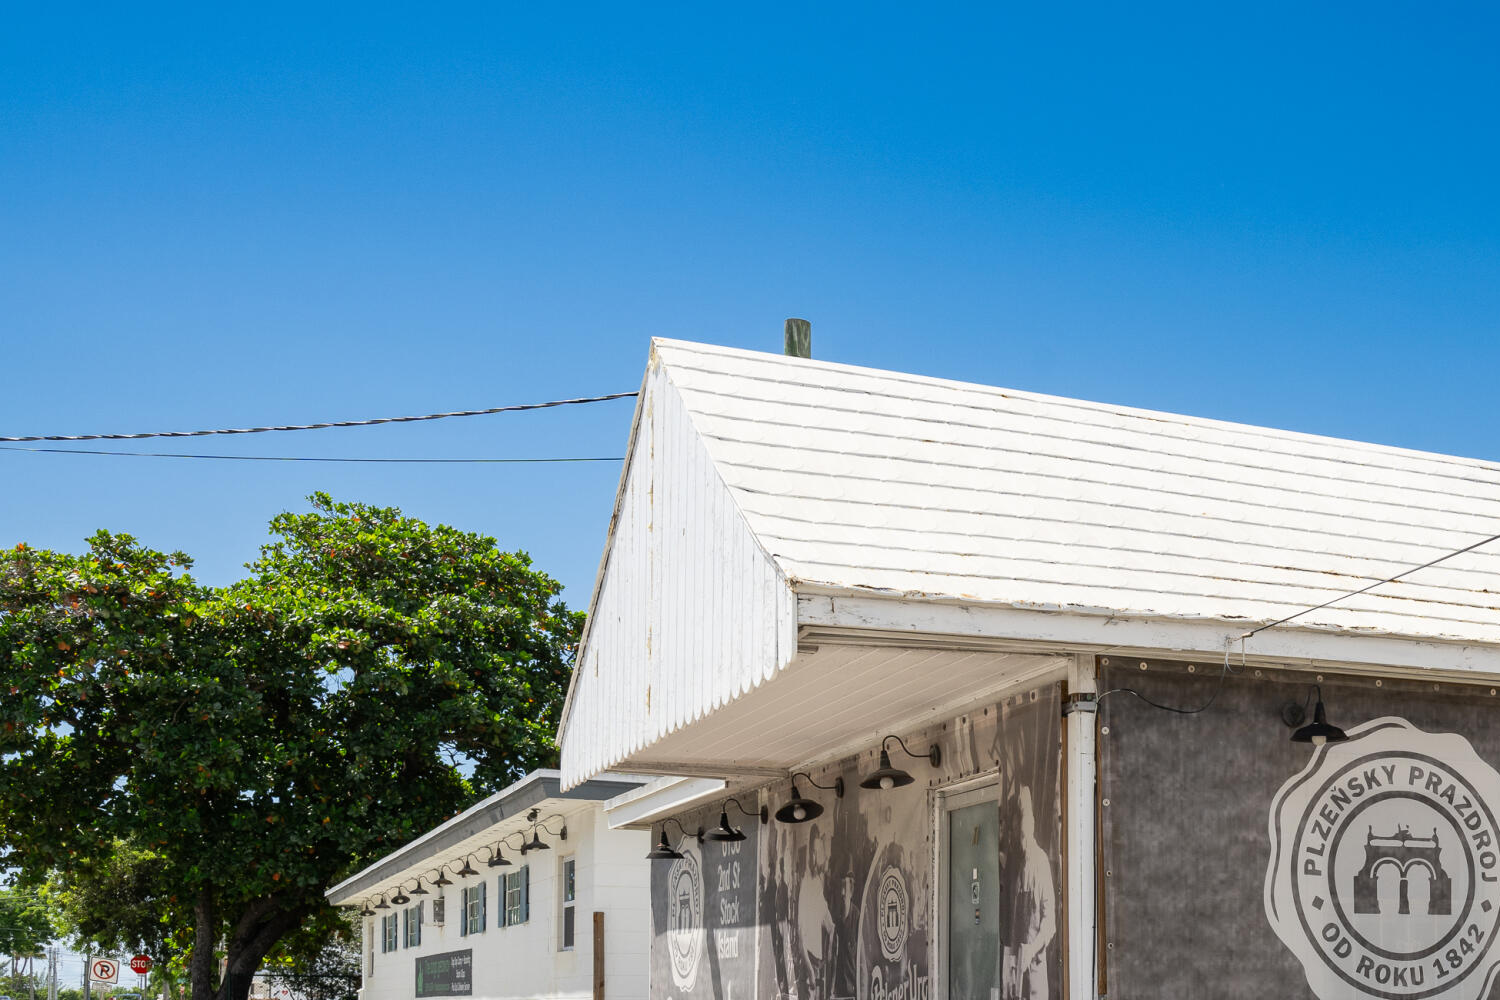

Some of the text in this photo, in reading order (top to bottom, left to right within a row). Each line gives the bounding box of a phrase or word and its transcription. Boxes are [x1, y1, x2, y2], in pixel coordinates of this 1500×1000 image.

[1408, 765, 1498, 883] PRAZDROJ
[720, 896, 740, 926] Stock
[1321, 921, 1485, 988] OD ROKU 1842
